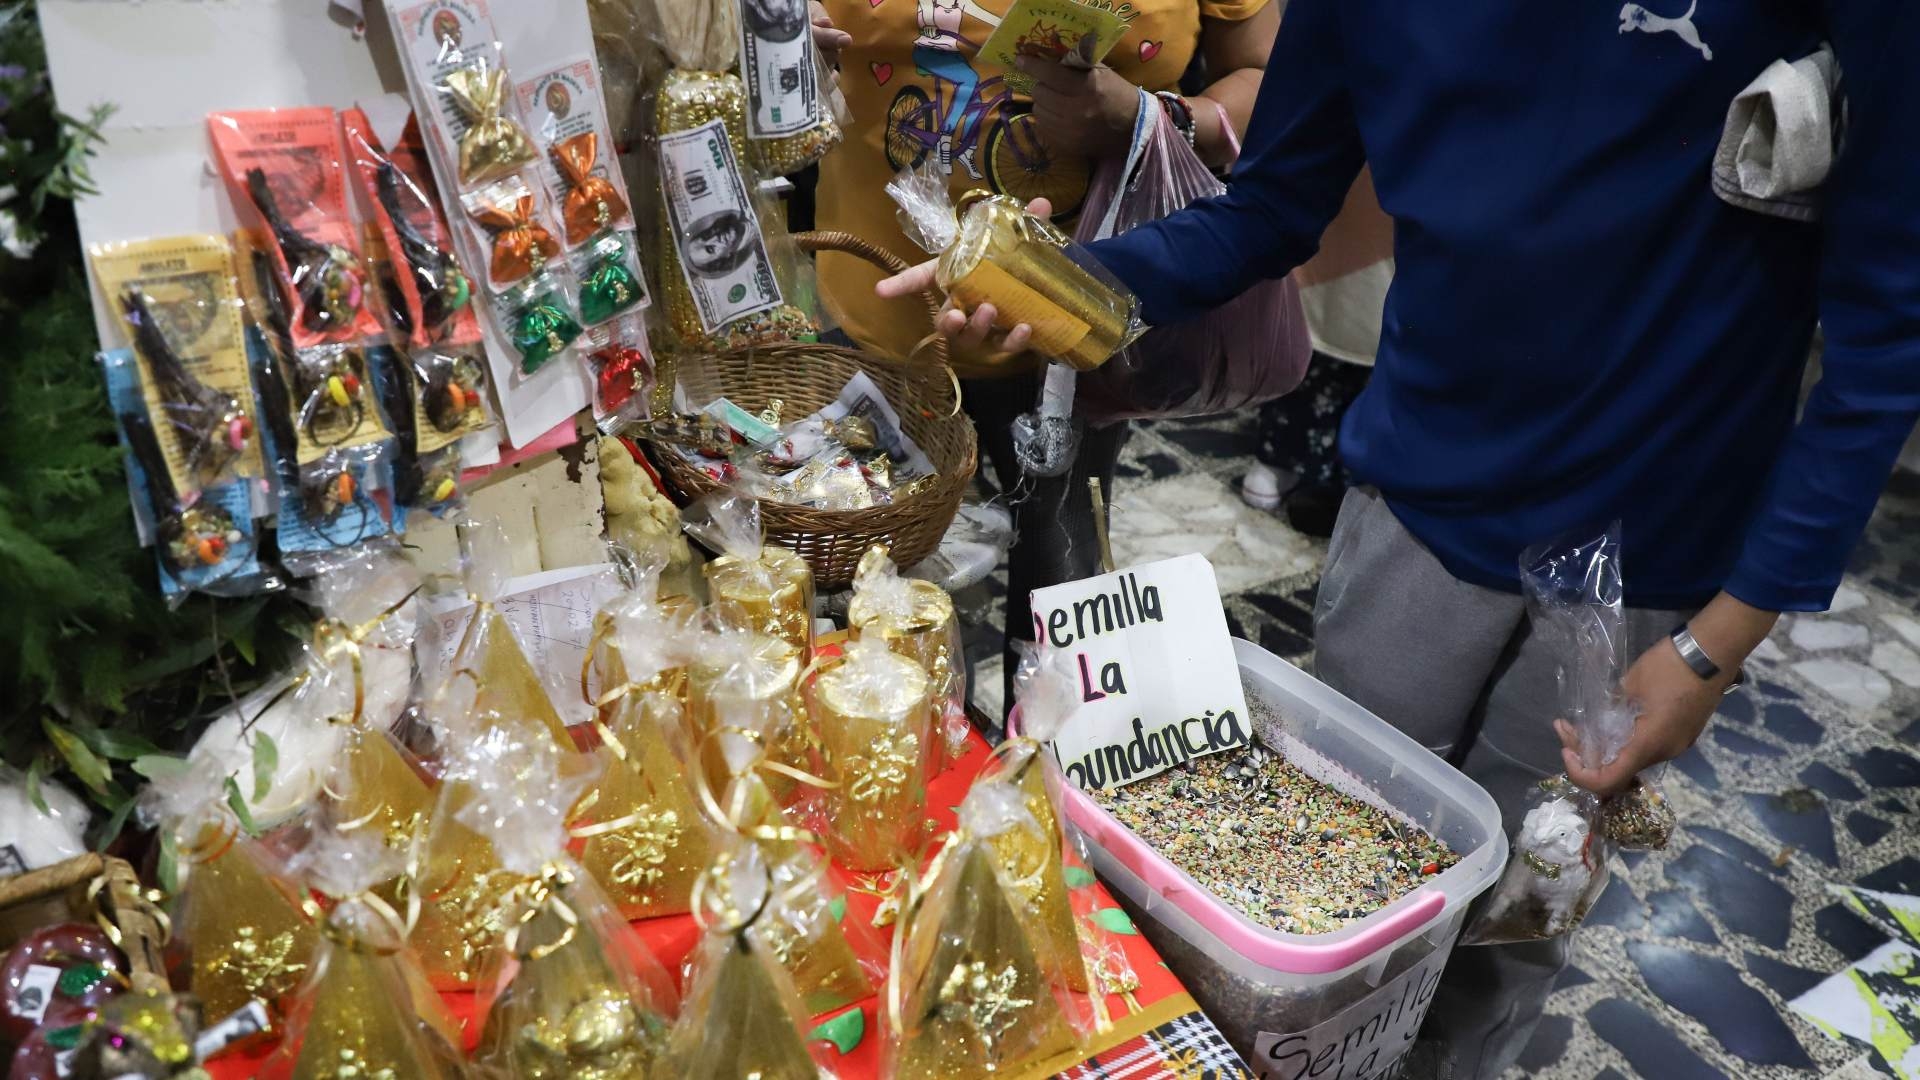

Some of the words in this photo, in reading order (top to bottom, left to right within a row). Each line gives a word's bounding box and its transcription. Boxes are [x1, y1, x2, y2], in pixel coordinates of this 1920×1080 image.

[708, 138, 724, 170] 100
[1077, 653, 1128, 703] La
[1053, 709, 1251, 791] bundancia
